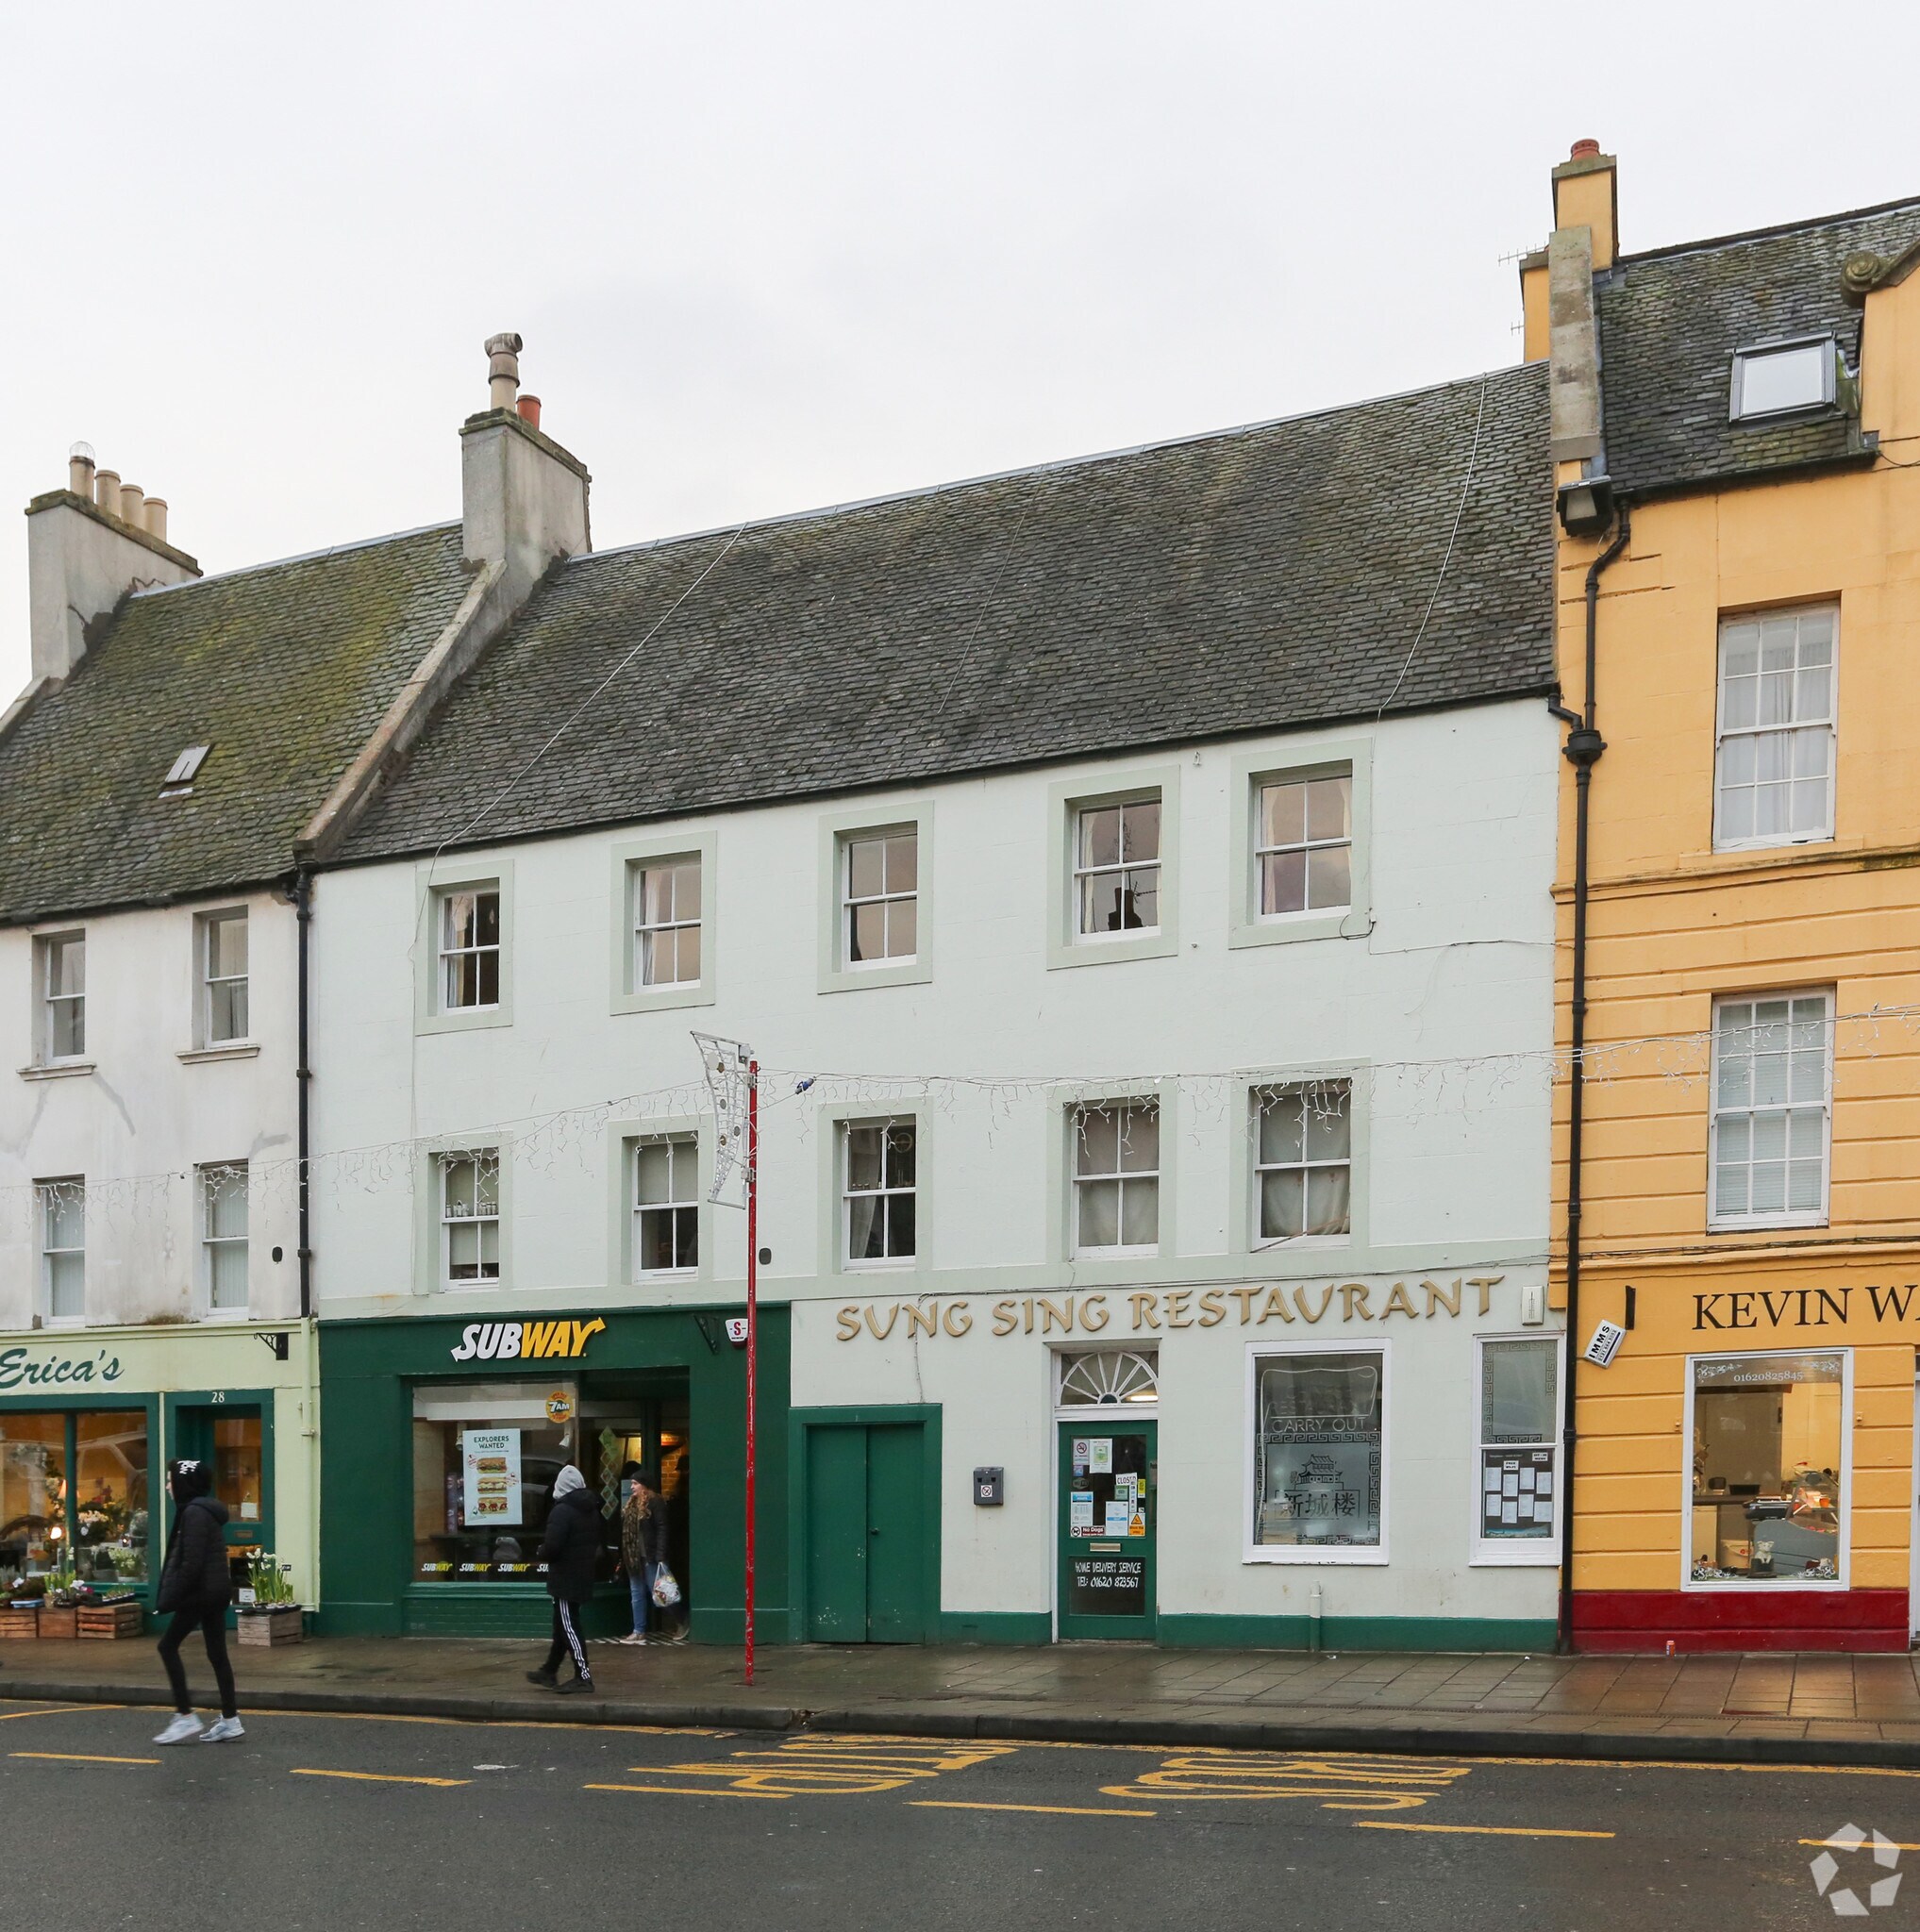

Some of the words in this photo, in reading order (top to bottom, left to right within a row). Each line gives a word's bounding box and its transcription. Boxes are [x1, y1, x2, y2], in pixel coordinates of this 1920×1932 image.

[836, 1300, 973, 1341] SUNG
[992, 1294, 1110, 1335] SING
[1127, 1274, 1506, 1330] RESTAURANT
[1692, 1287, 1854, 1330] KEVIN
[1864, 1284, 1920, 1323] W
[450, 1316, 606, 1362] SUBWAY
[0, 1347, 125, 1390] Erica's
[1734, 1371, 1804, 1382] 01620825845
[211, 1391, 225, 1403] 28
[1271, 1418, 1326, 1433] CARRY
[1332, 1417, 1368, 1432] OUT
[474, 1435, 509, 1443] EXPLORERS
[421, 1563, 453, 1572] SUBWAY
[459, 1563, 492, 1572] SUBWAY
[498, 1563, 530, 1572] SUBWAY
[1076, 1562, 1091, 1573] HOME
[1093, 1562, 1117, 1573] DELIVERY
[1119, 1562, 1142, 1574] SERVICE
[1091, 1576, 1112, 1588] 01620
[1114, 1576, 1139, 1588] 823567
